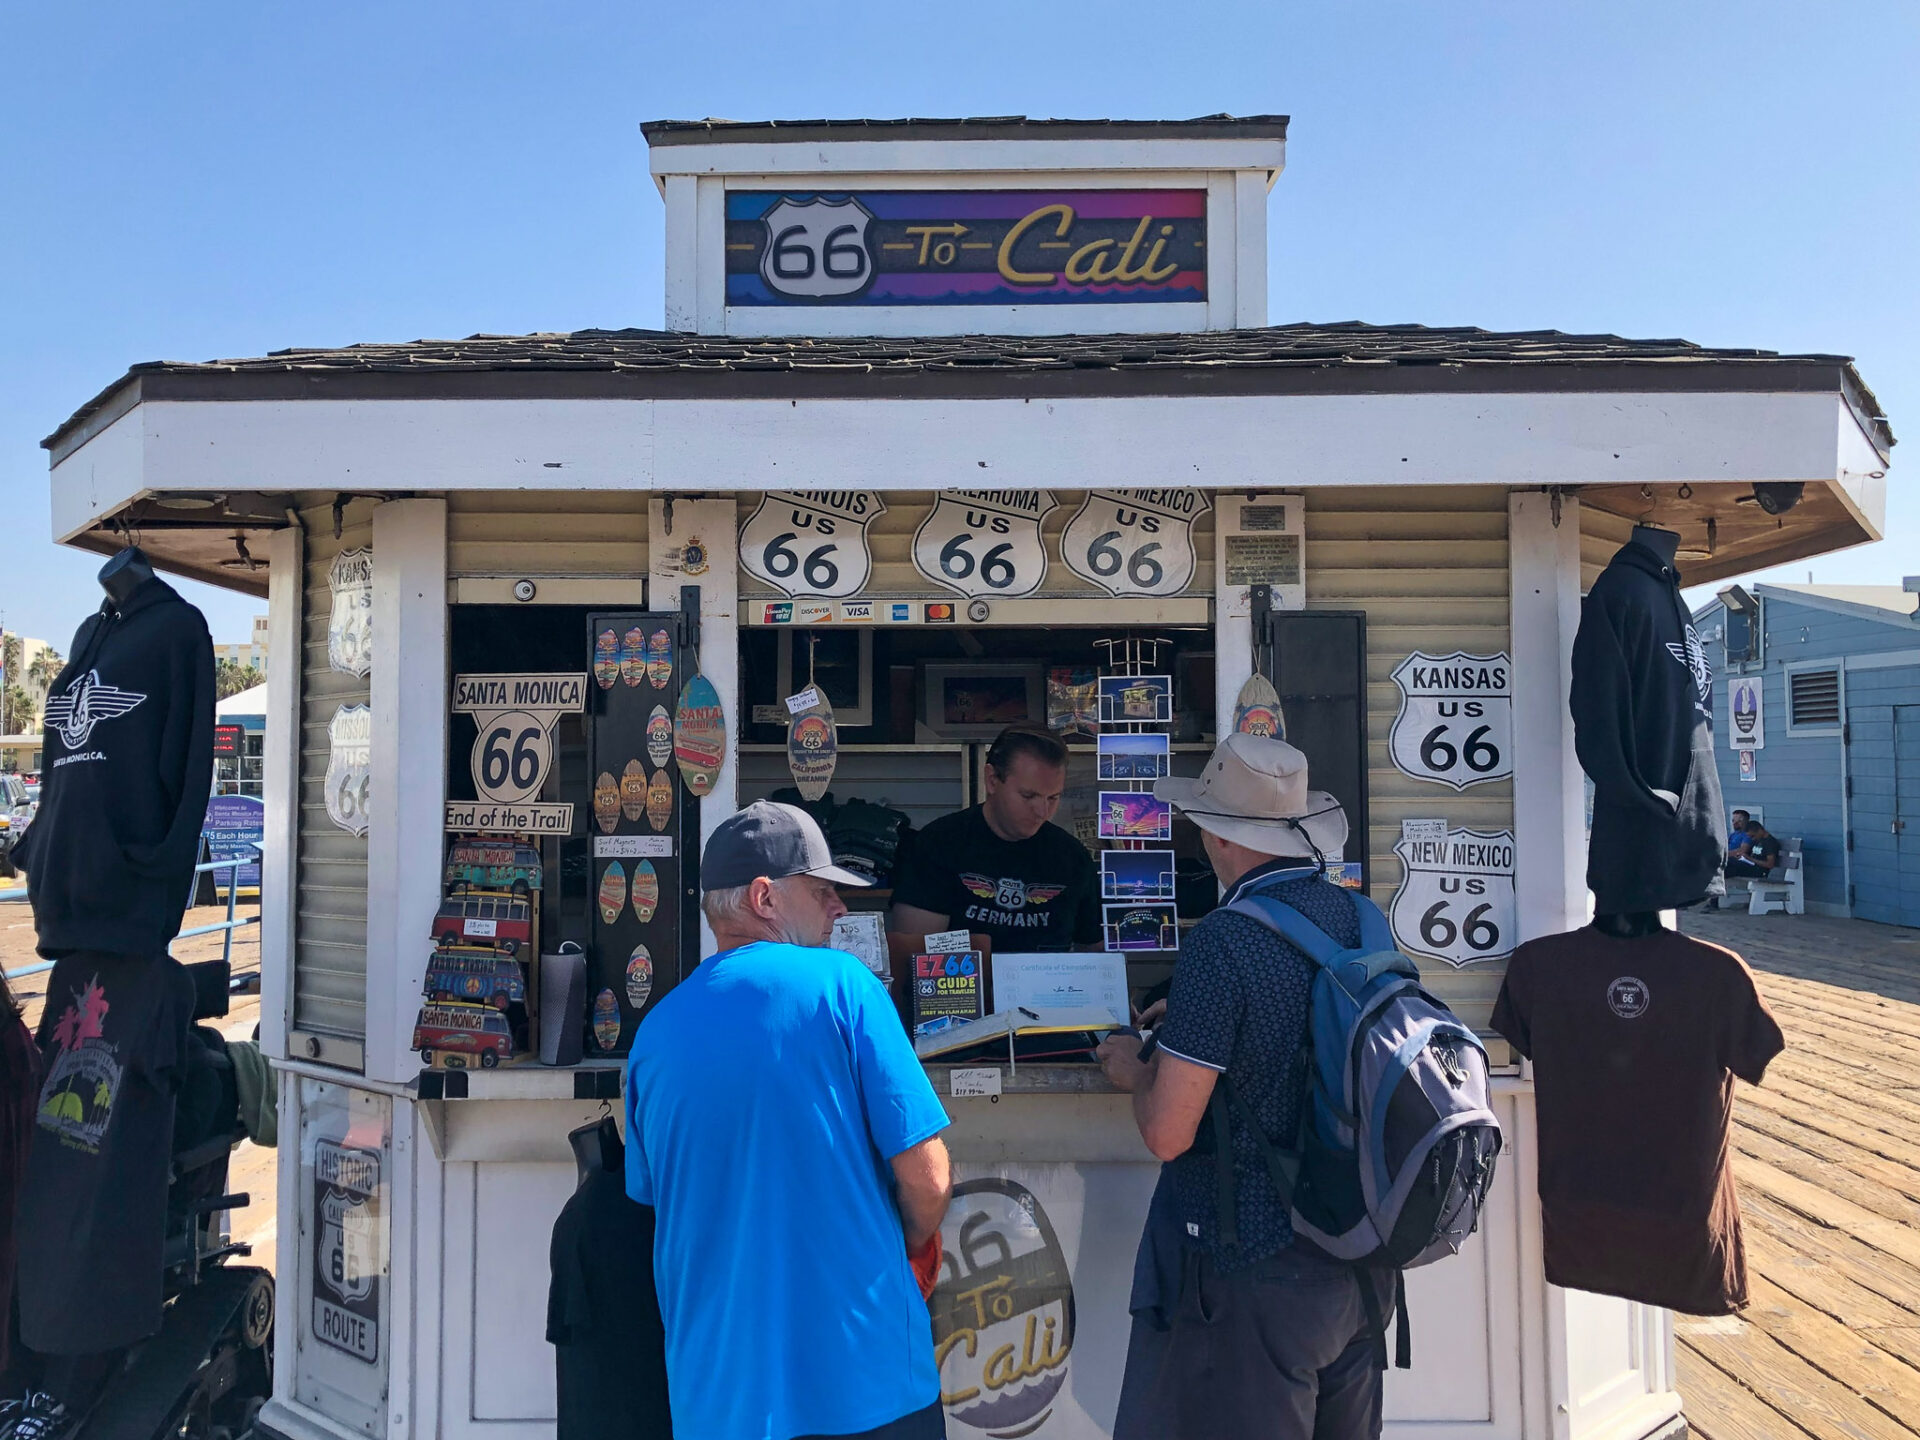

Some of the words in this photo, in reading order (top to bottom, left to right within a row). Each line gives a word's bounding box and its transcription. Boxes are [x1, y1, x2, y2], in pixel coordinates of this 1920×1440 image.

[773, 224, 866, 279] 66
[905, 223, 962, 266] To
[997, 204, 1178, 284] Cali
[791, 510, 836, 535] US
[966, 511, 1011, 534] US
[1116, 508, 1160, 533] US
[763, 532, 839, 589] 66
[940, 533, 1016, 589] 66
[1087, 531, 1163, 588] 66
[801, 607, 830, 615] DISCOVER
[846, 607, 870, 616] VISA
[1412, 667, 1506, 690] KANSAS
[457, 681, 507, 705] SANTA
[513, 681, 580, 705] MONICA
[680, 706, 719, 719] SANTA
[1438, 701, 1484, 717] US
[805, 738, 820, 748] 66
[1420, 724, 1500, 773] 66
[482, 727, 541, 789] 66
[791, 763, 833, 773] CALIFORNIA
[445, 807, 475, 826] End
[479, 808, 498, 827] of
[501, 808, 527, 828] the
[530, 809, 567, 829] Trail
[1113, 810, 1123, 818] 66
[455, 848, 479, 862] SANTA
[485, 849, 514, 863] MONICA
[1411, 842, 1448, 865] NEW
[1453, 843, 1512, 868] MEXICO
[1001, 879, 1021, 888] ROUTE
[1330, 873, 1340, 882] 66
[1439, 877, 1485, 895] US
[999, 888, 1022, 906] 66
[965, 904, 1050, 928] GERMANY
[1420, 900, 1500, 951] 66
[634, 972, 646, 981] 66
[916, 954, 975, 977] EZ66
[1021, 964, 1053, 972] Certificate
[921, 986, 933, 994] 66
[936, 977, 976, 989] GUIDE
[1622, 993, 1634, 1003] 66
[423, 1010, 449, 1027] SANTA
[450, 1012, 482, 1030] MONICA
[320, 1149, 373, 1191] HISTORIC
[327, 1203, 364, 1232] CALIFORNIA
[336, 1229, 355, 1250] US
[331, 1247, 360, 1291] 66
[957, 1277, 1013, 1330] To
[323, 1306, 366, 1351] ROUTE
[934, 1314, 1068, 1406] Cali
